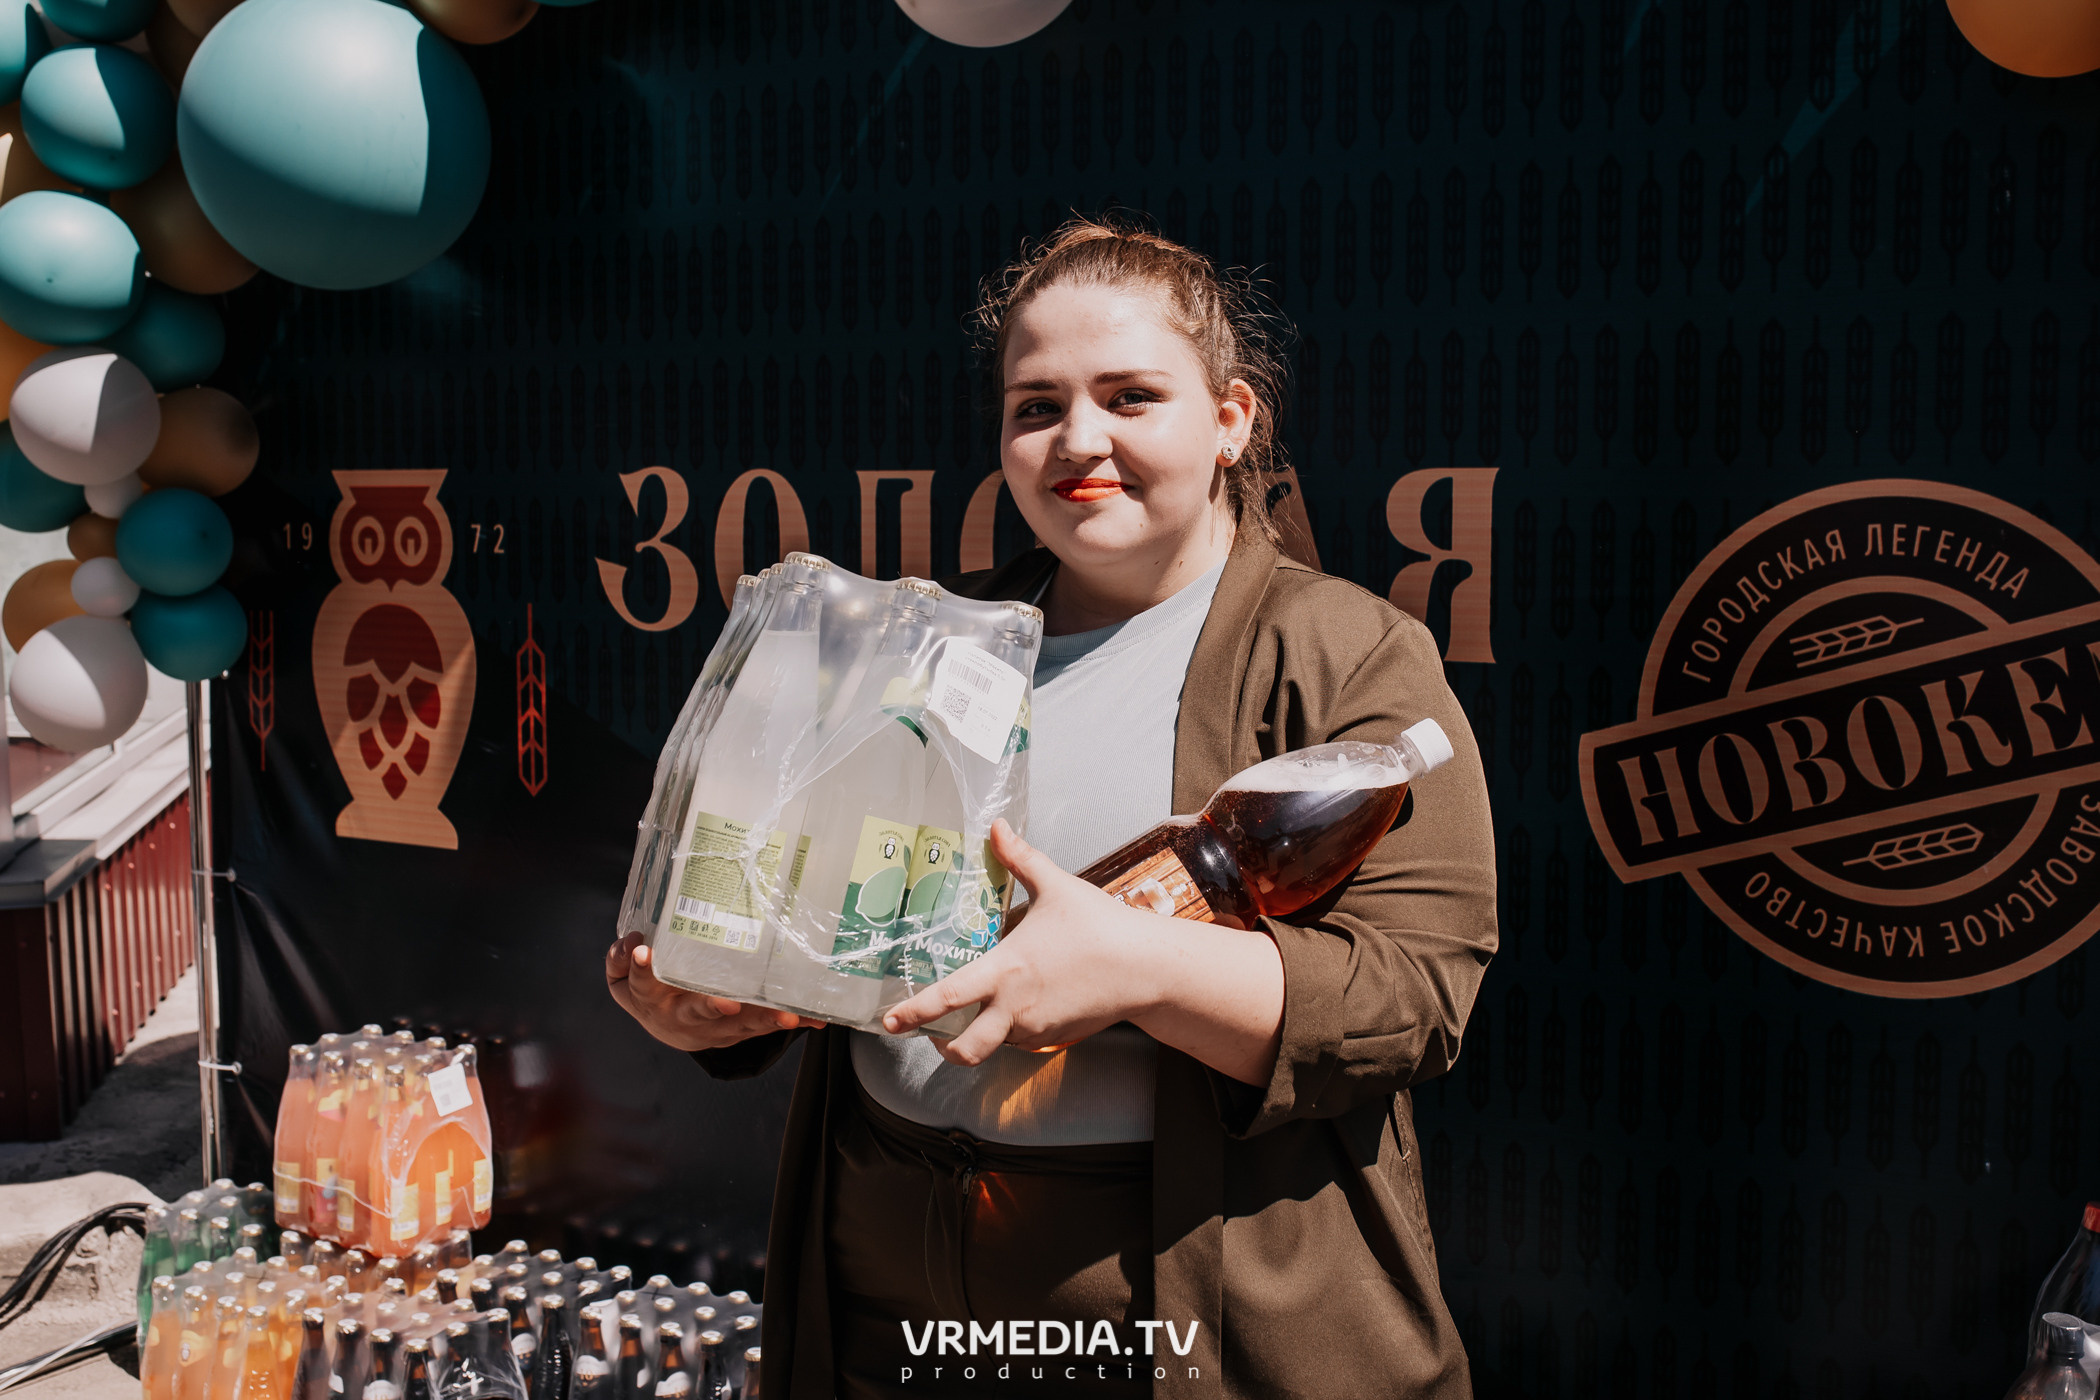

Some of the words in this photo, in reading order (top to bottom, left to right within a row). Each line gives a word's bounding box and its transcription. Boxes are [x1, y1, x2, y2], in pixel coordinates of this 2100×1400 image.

[283, 522, 313, 550] 19
[471, 524, 505, 553] 72
[1682, 529, 1847, 683] ГОРОДСКАЯ
[1864, 523, 2030, 599] ЛЕГЕНДА
[1744, 872, 1925, 958] КАЧЕСТВО
